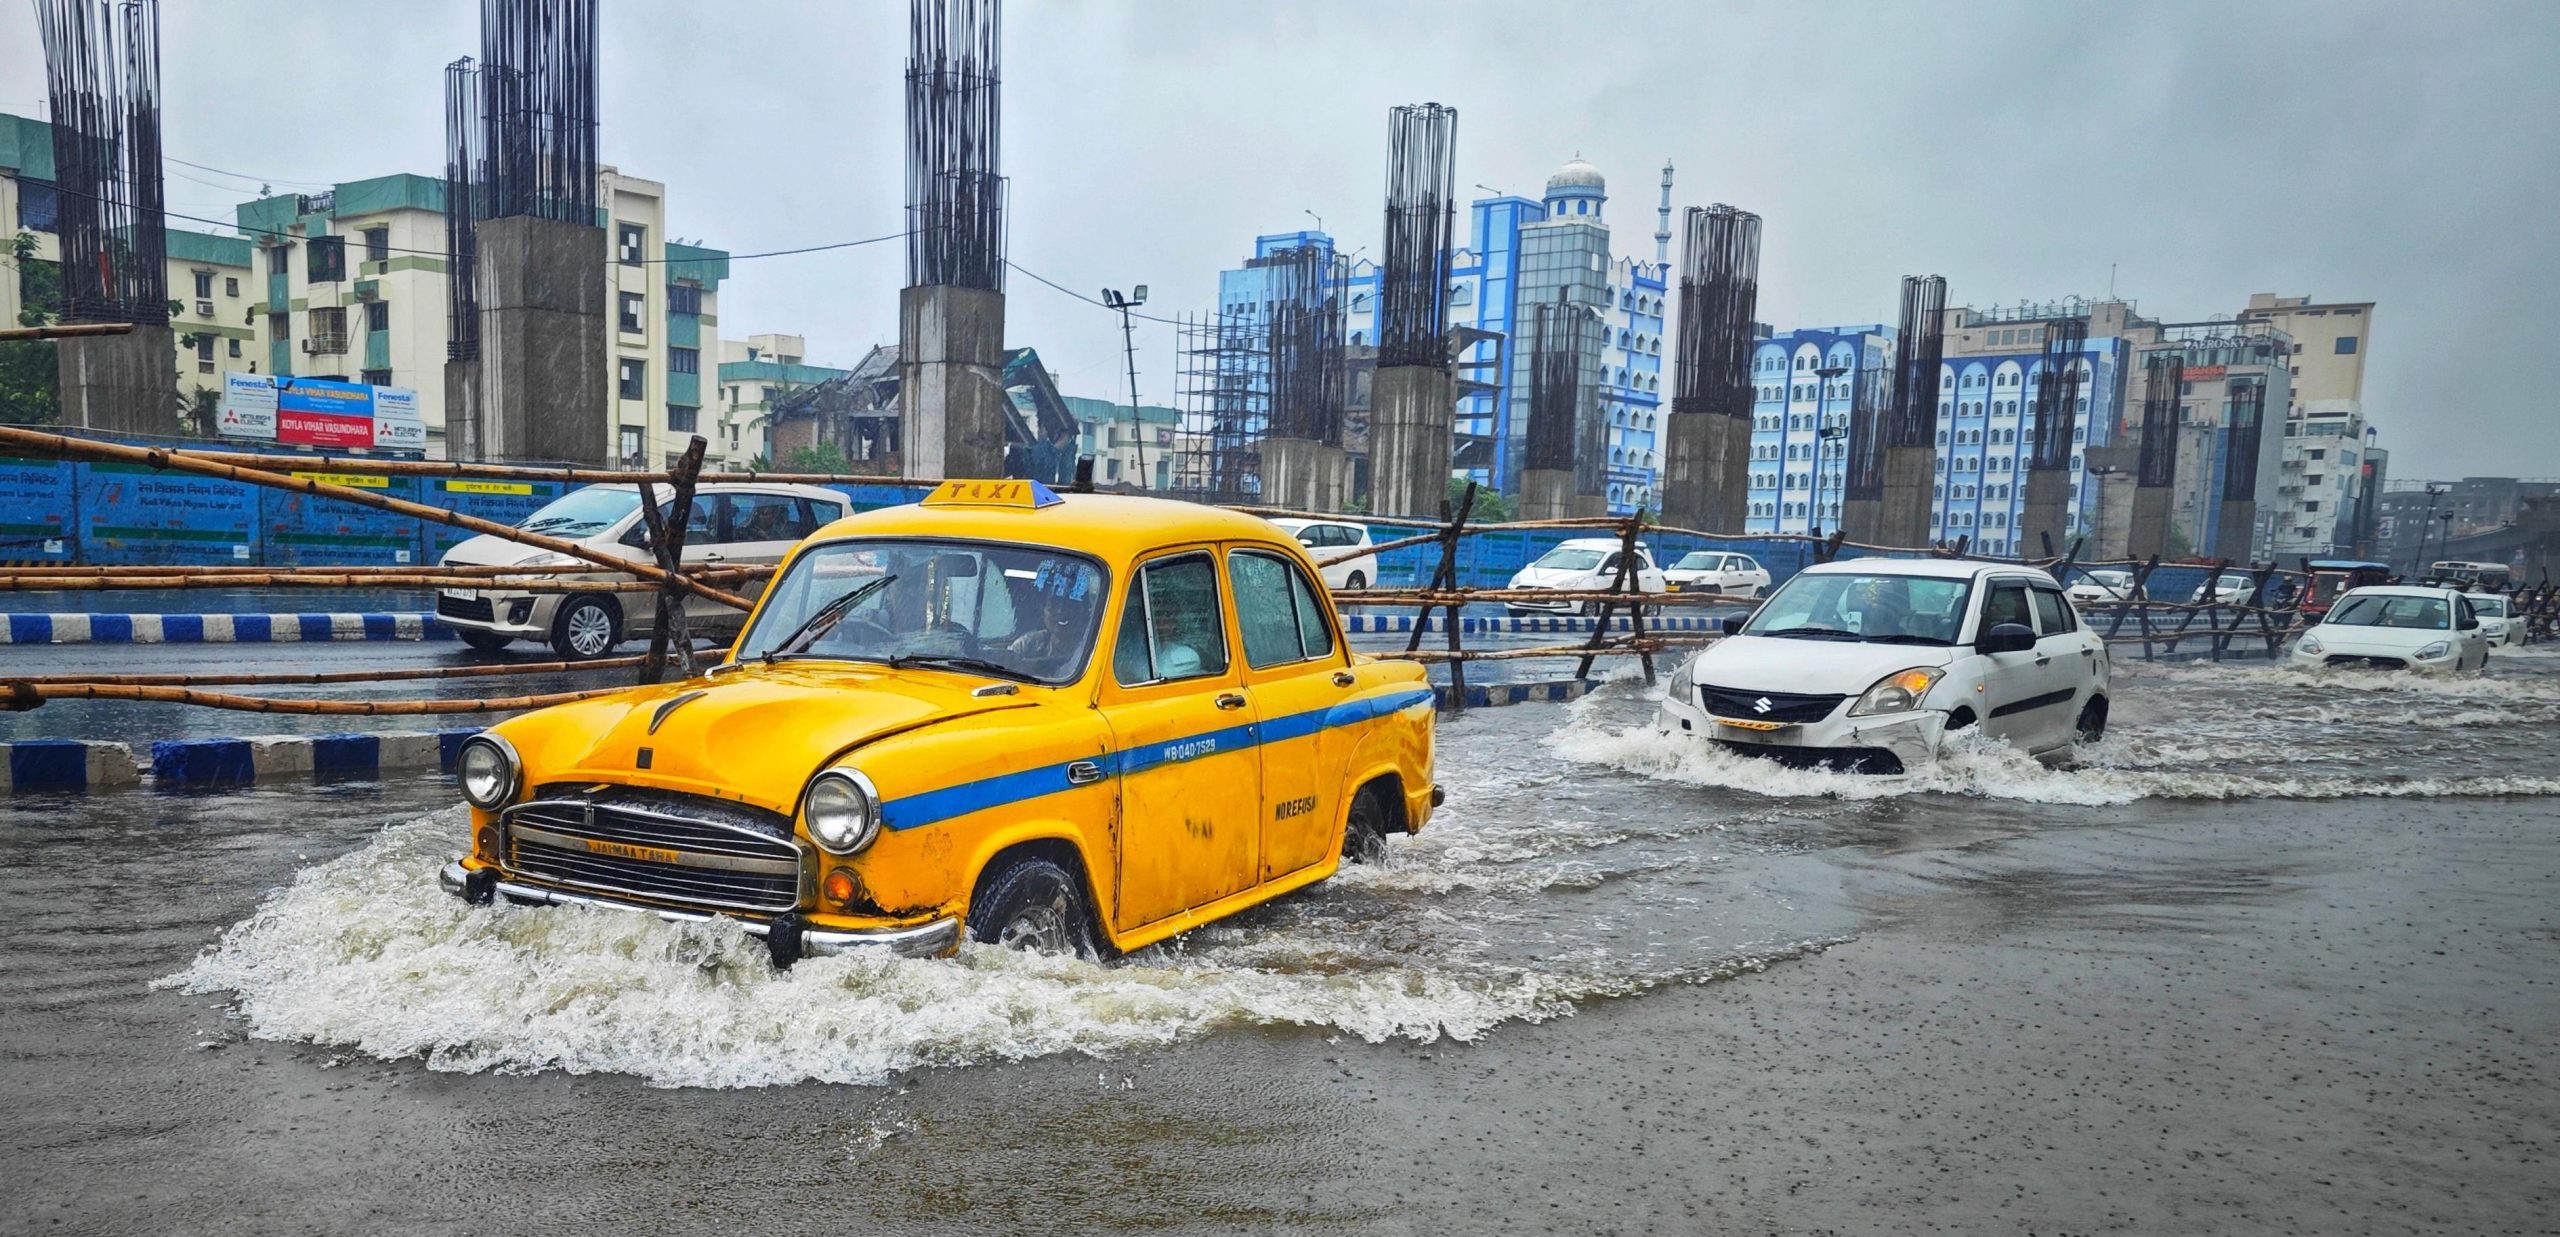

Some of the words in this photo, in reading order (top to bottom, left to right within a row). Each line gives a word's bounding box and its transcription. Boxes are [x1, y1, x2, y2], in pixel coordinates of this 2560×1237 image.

[2191, 339, 2246, 349] AEROSKY
[230, 377, 268, 389] Fenesta
[377, 392, 411, 402] Fenesta
[240, 413, 271, 421] MITSUBISHI
[240, 419, 268, 427] ELECTRIC
[282, 419, 303, 431] KOYLA
[304, 421, 324, 433] VIHAR
[325, 422, 369, 436] VASUNDHARA
